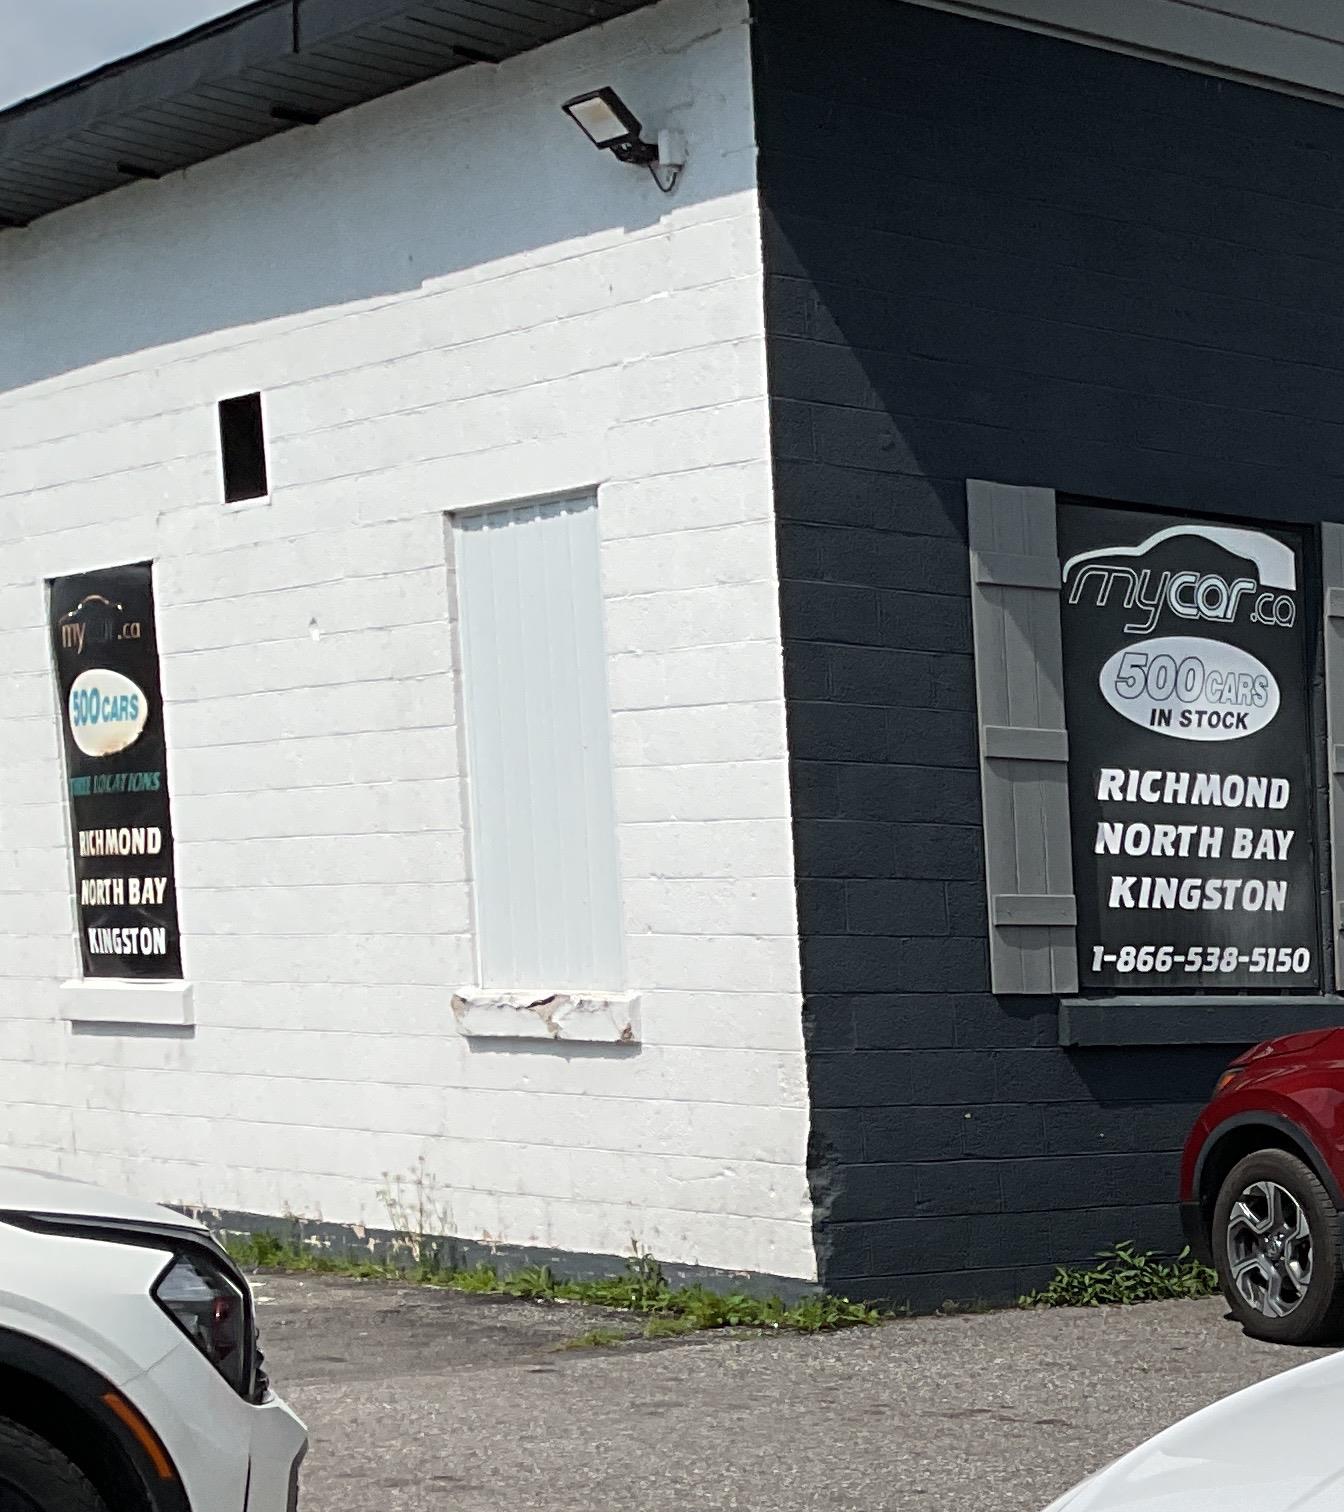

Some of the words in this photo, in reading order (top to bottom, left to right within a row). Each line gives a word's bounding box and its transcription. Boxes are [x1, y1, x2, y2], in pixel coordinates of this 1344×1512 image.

[1068, 565, 1296, 634] mycar.ca
[61, 621, 141, 654] my.ca
[1150, 708, 1174, 728] IN
[1179, 709, 1249, 731] STOCK
[1097, 768, 1290, 811] RICHMOND
[78, 826, 162, 857] RICHMOND
[1094, 822, 1222, 859] NORTH
[1231, 827, 1296, 862] BAY
[81, 878, 124, 906] NORTH
[129, 877, 167, 905] BAY
[1108, 876, 1288, 913] KINGSTON
[88, 926, 166, 956] KINGSTON
[1091, 944, 1311, 974] 1-866-538-5150
